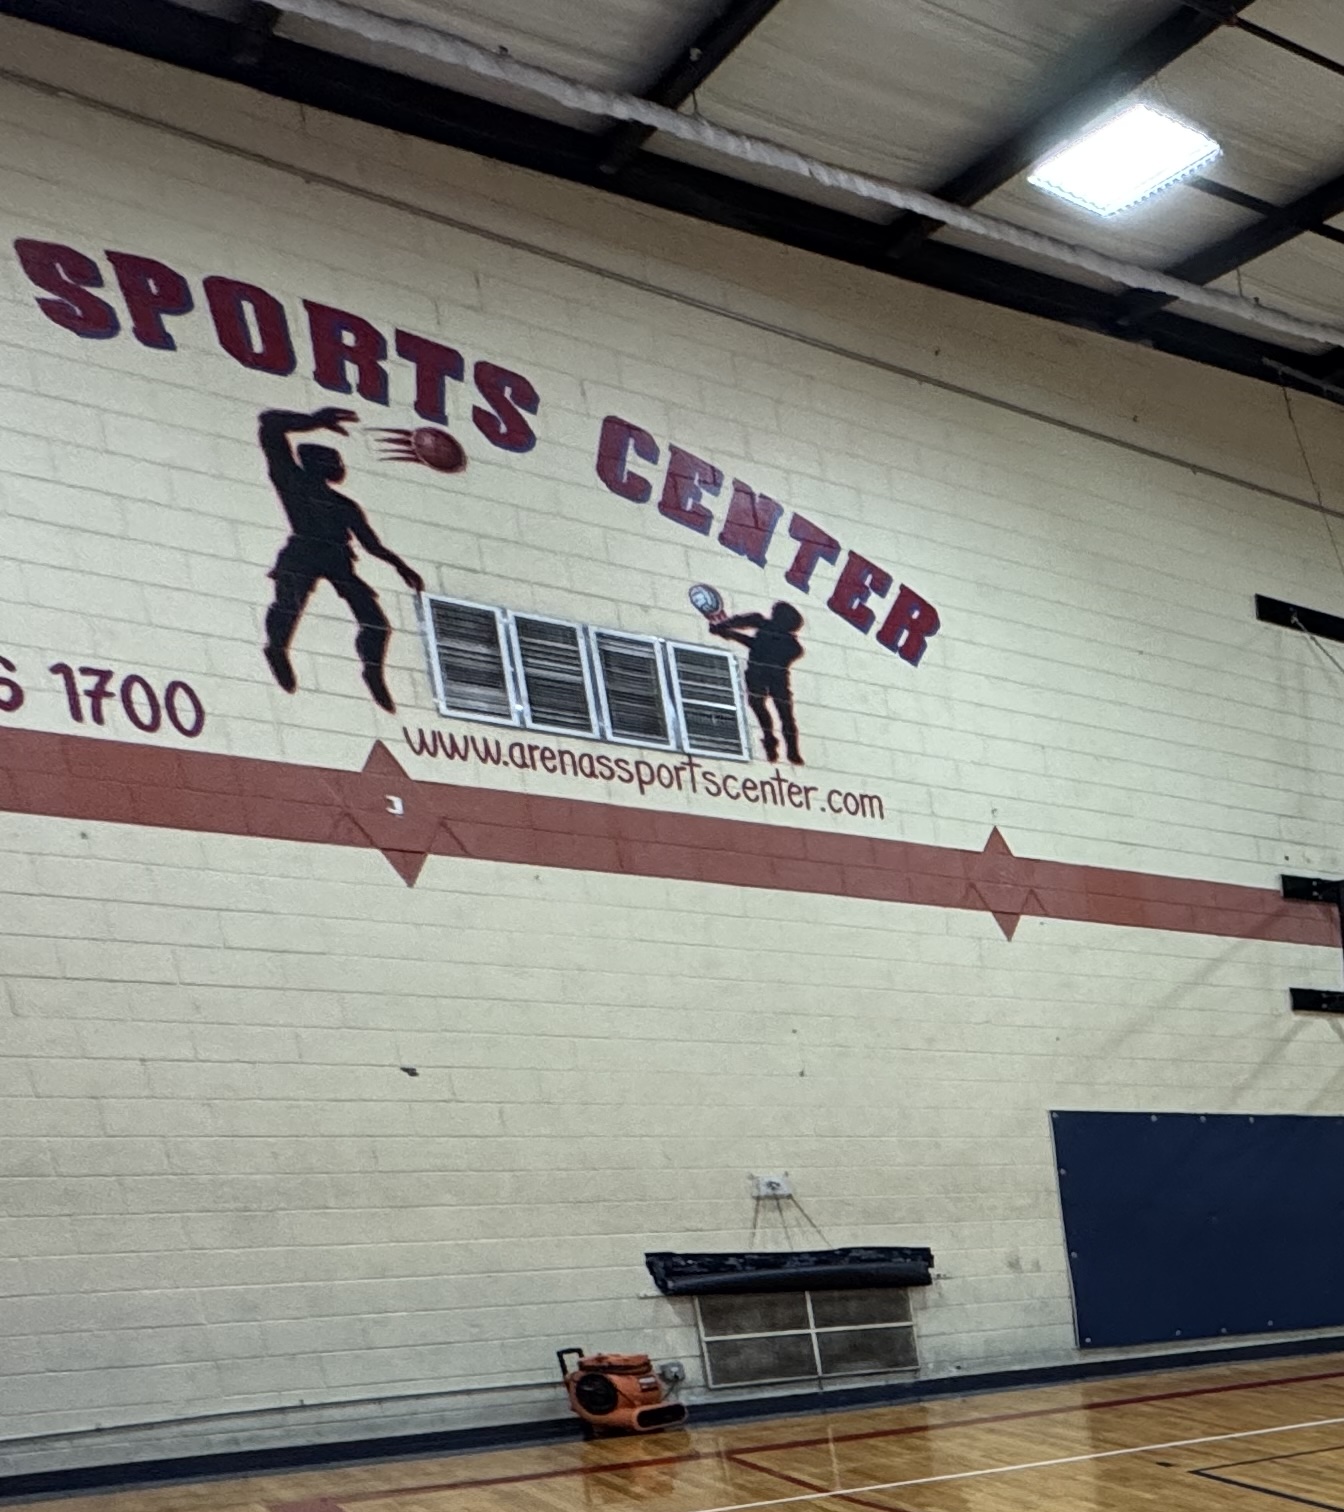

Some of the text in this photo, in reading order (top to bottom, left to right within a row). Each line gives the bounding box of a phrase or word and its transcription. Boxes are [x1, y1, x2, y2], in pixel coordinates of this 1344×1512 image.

[14, 237, 941, 667] SPORTS CENTER
[49, 662, 205, 737] 1700
[402, 724, 884, 821] www.arenassportscenter.com
